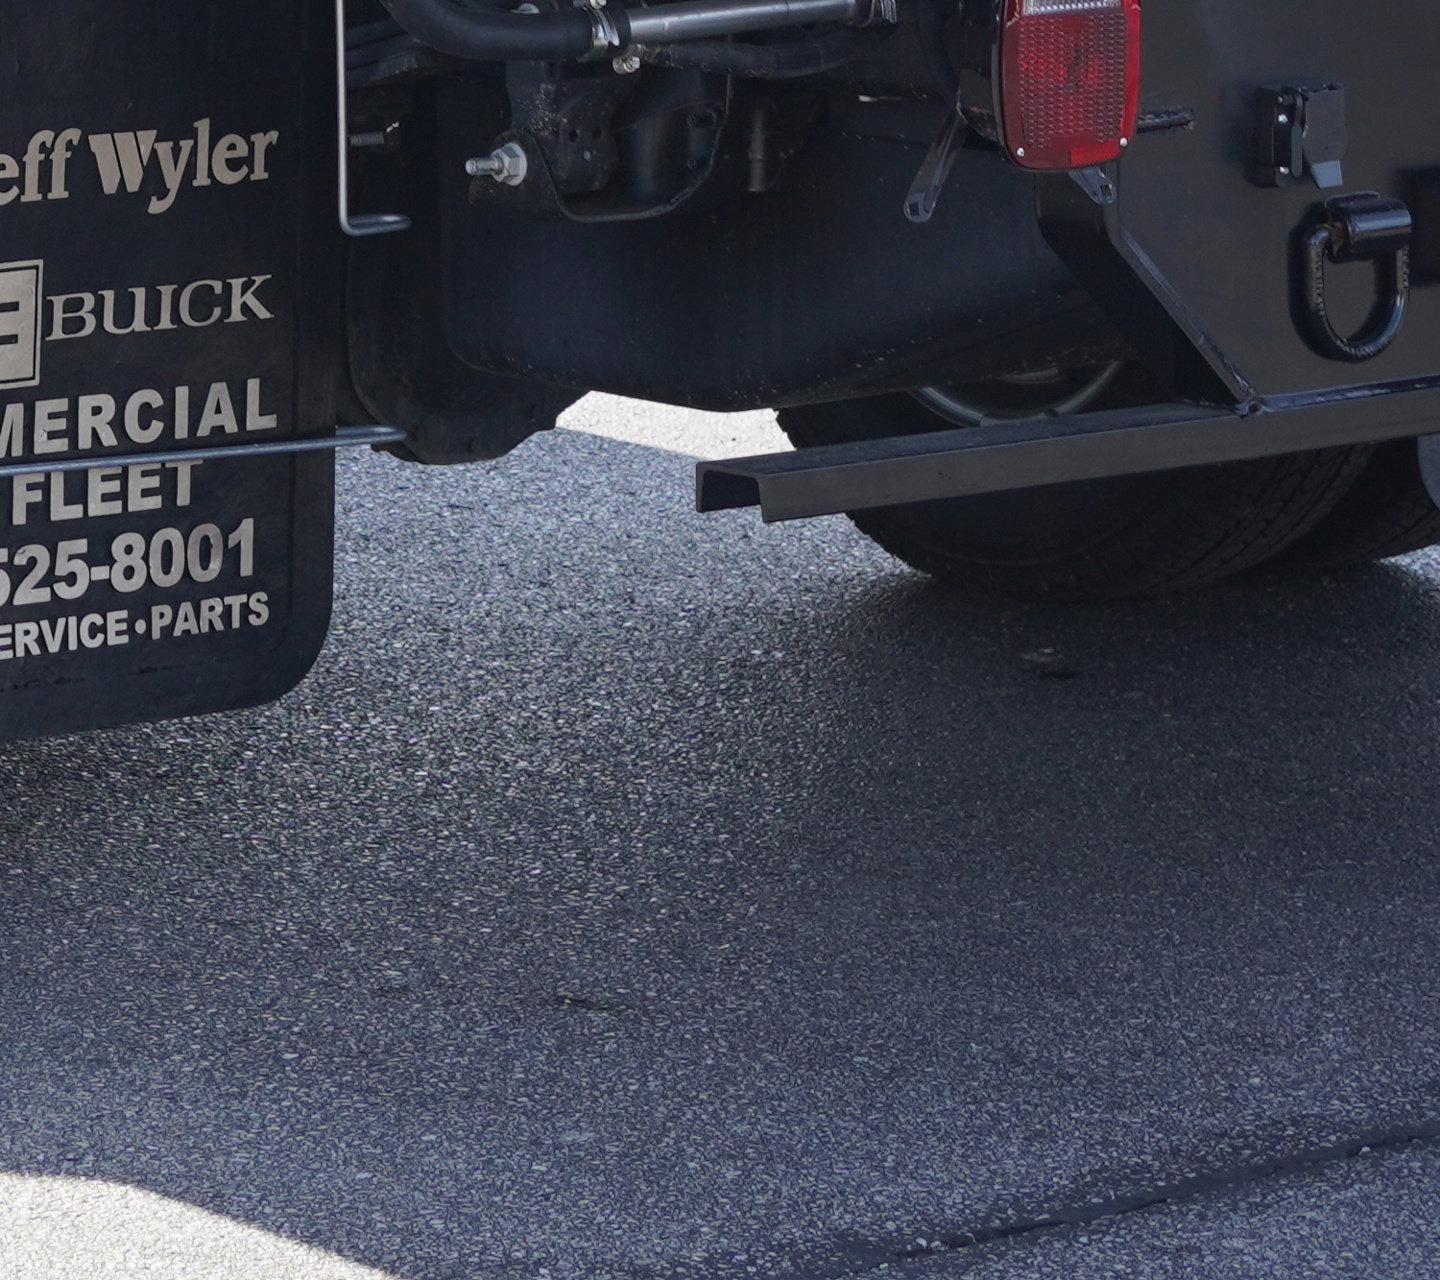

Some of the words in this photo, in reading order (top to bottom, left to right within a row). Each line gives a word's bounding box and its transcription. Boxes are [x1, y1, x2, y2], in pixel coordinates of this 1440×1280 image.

[88, 118, 279, 214] Wyler
[45, 274, 275, 341] BUICK
[12, 459, 204, 526] FLEET
